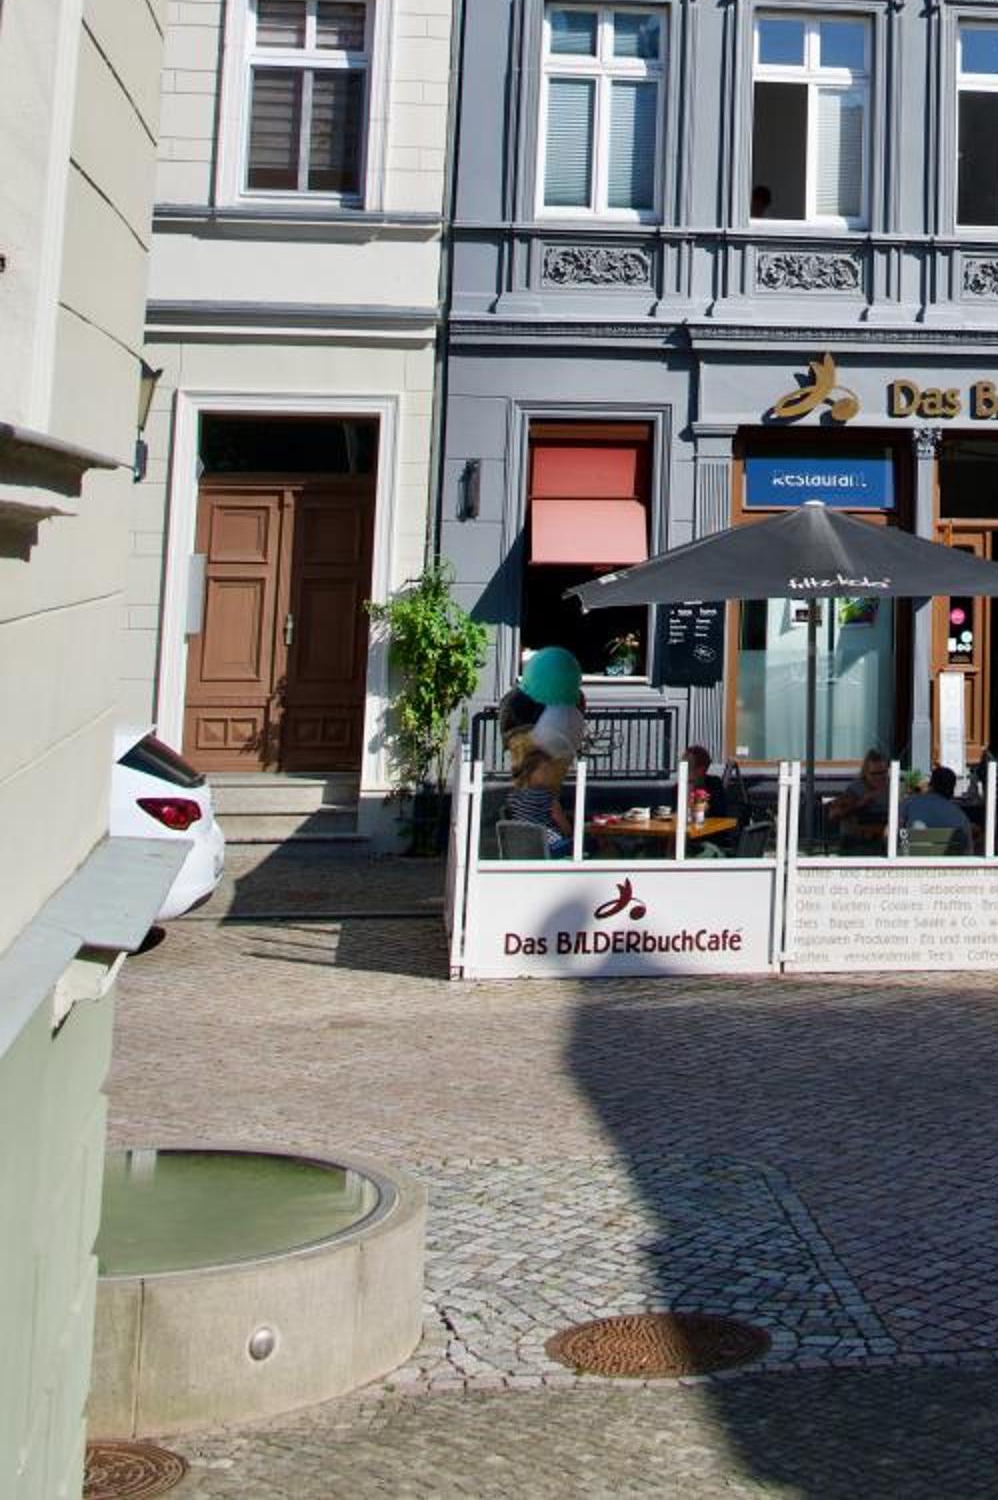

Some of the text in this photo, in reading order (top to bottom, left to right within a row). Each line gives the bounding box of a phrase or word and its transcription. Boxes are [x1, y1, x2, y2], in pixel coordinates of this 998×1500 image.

[888, 379, 961, 419] Das
[504, 927, 744, 956] Das BILDERbuchCafé
